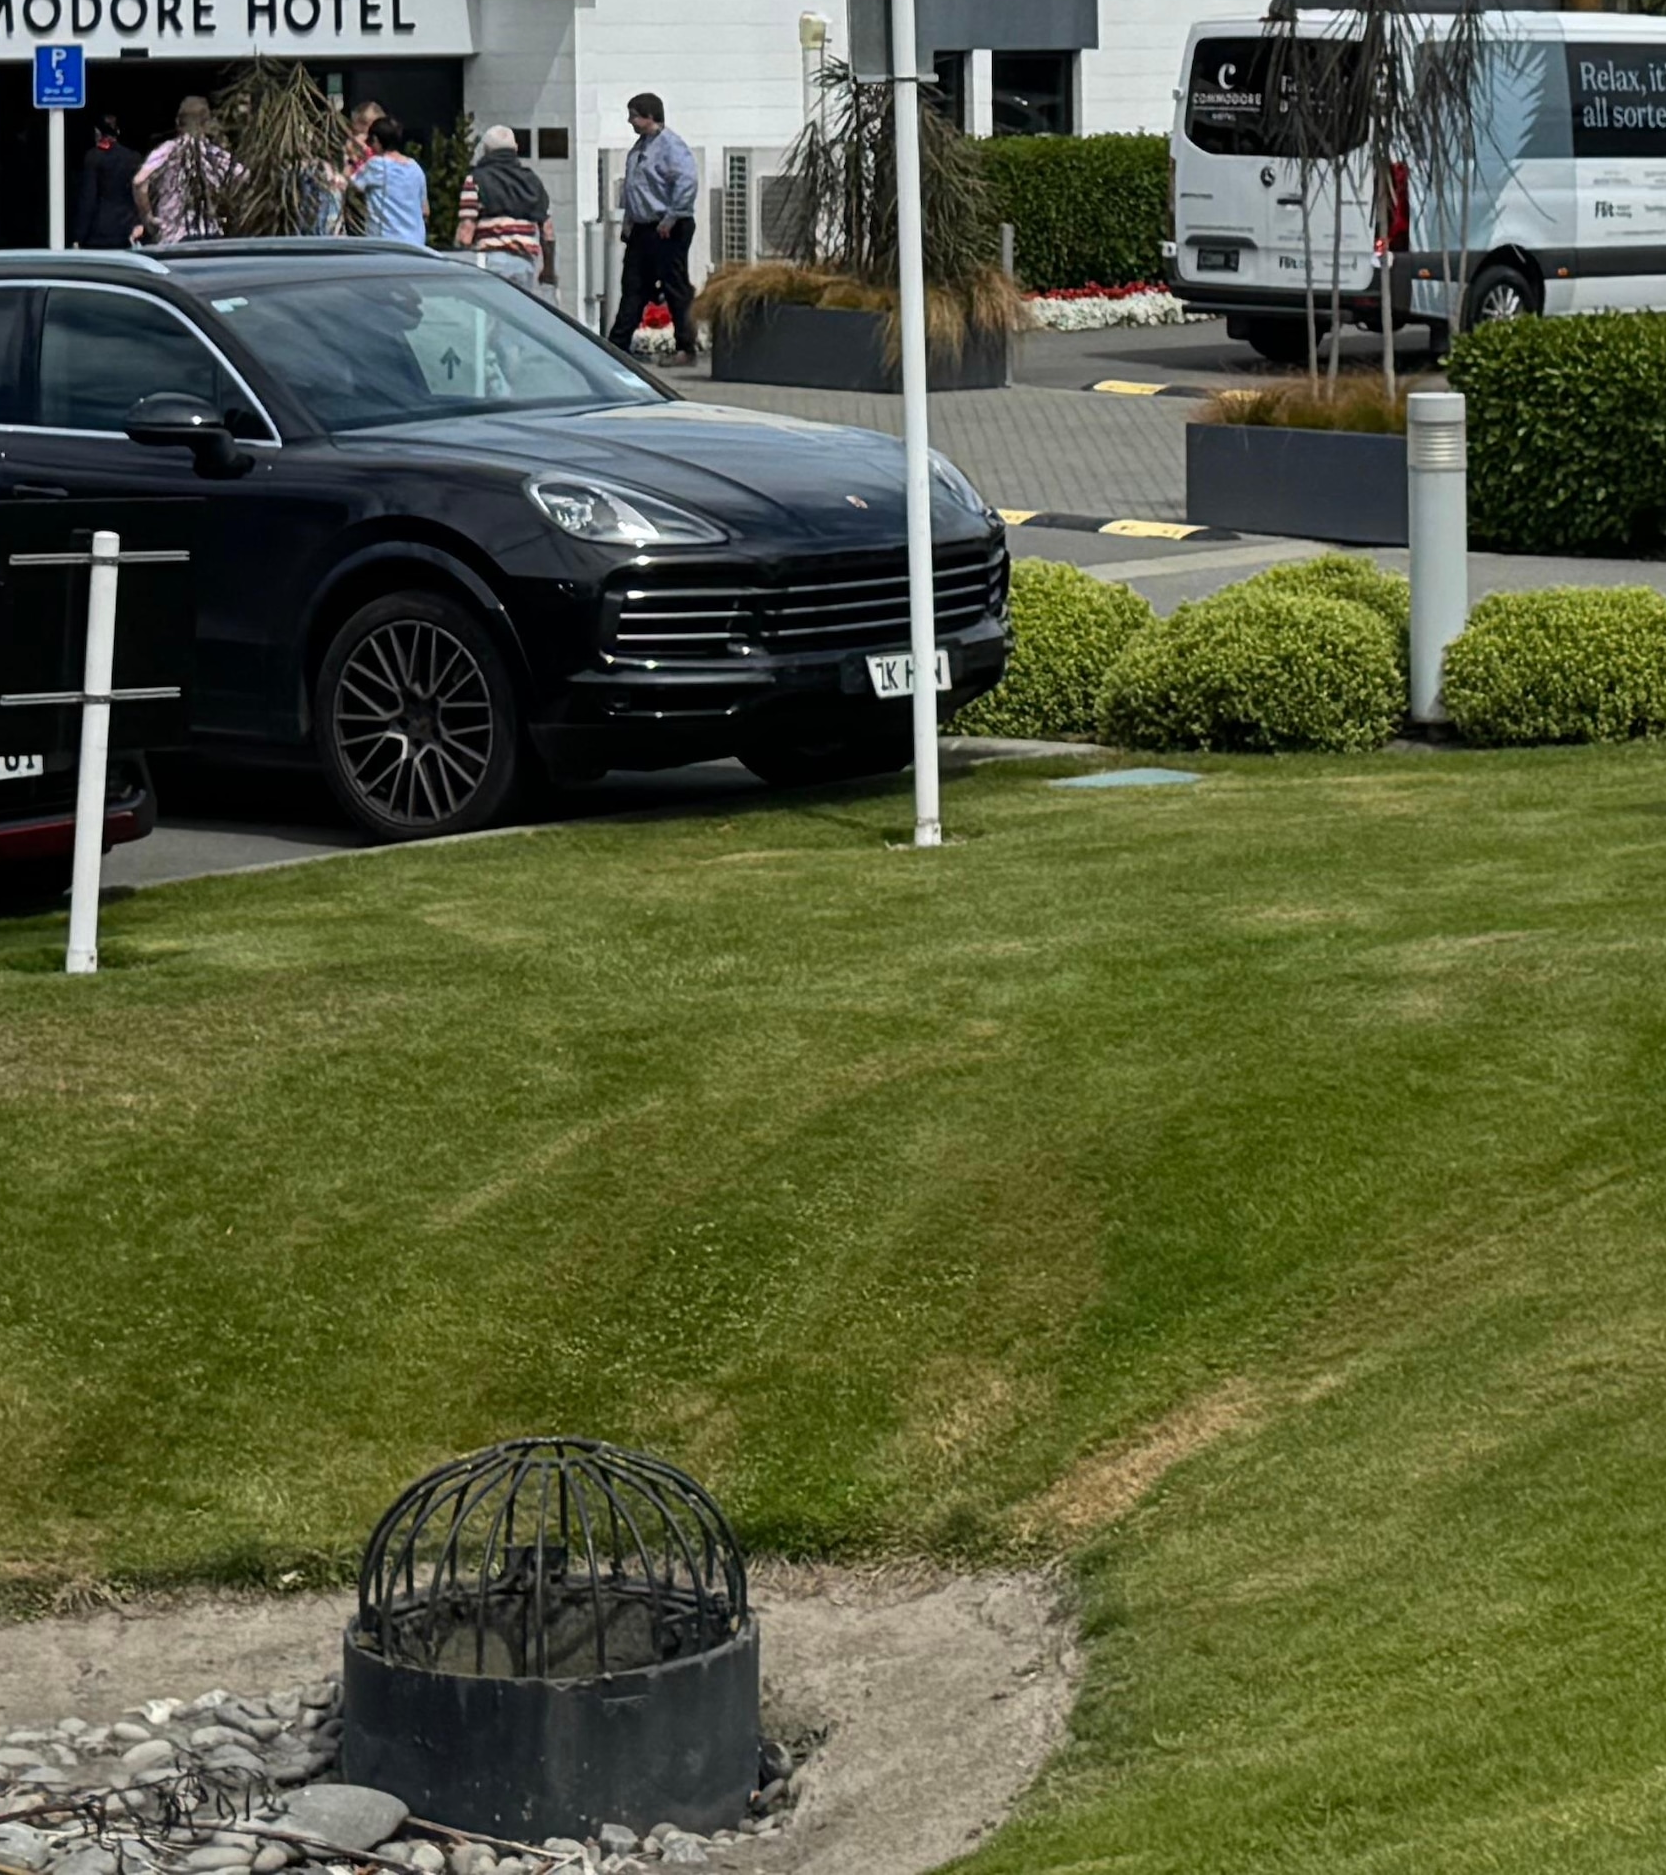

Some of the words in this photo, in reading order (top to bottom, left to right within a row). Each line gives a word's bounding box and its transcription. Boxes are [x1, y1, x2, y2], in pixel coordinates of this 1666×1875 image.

[51, 48, 67, 70] P
[1579, 60, 1648, 97] Relax,
[1583, 96, 1609, 128] all
